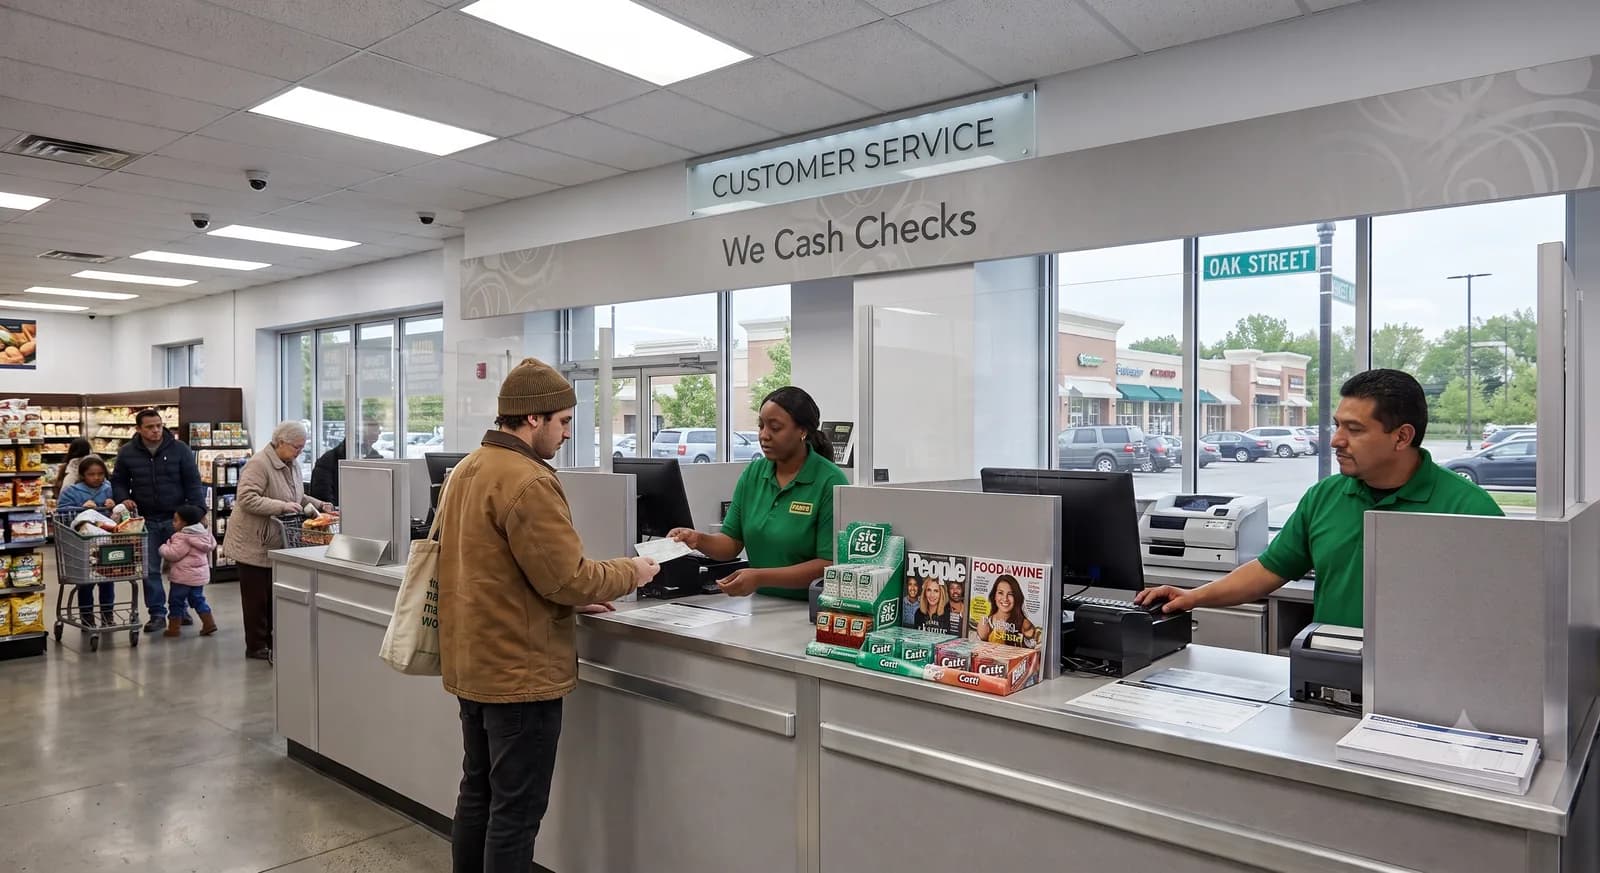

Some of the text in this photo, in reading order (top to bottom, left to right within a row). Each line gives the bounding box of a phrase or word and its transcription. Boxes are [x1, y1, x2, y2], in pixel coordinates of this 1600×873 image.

[712, 117, 995, 199] CUSTOMER SERVICE
[722, 202, 977, 267] We Cash Checks
[1209, 250, 1311, 277] OAK STREET
[906, 553, 966, 586] People
[973, 561, 1004, 575] FOOD
[1011, 565, 1043, 580] WINE
